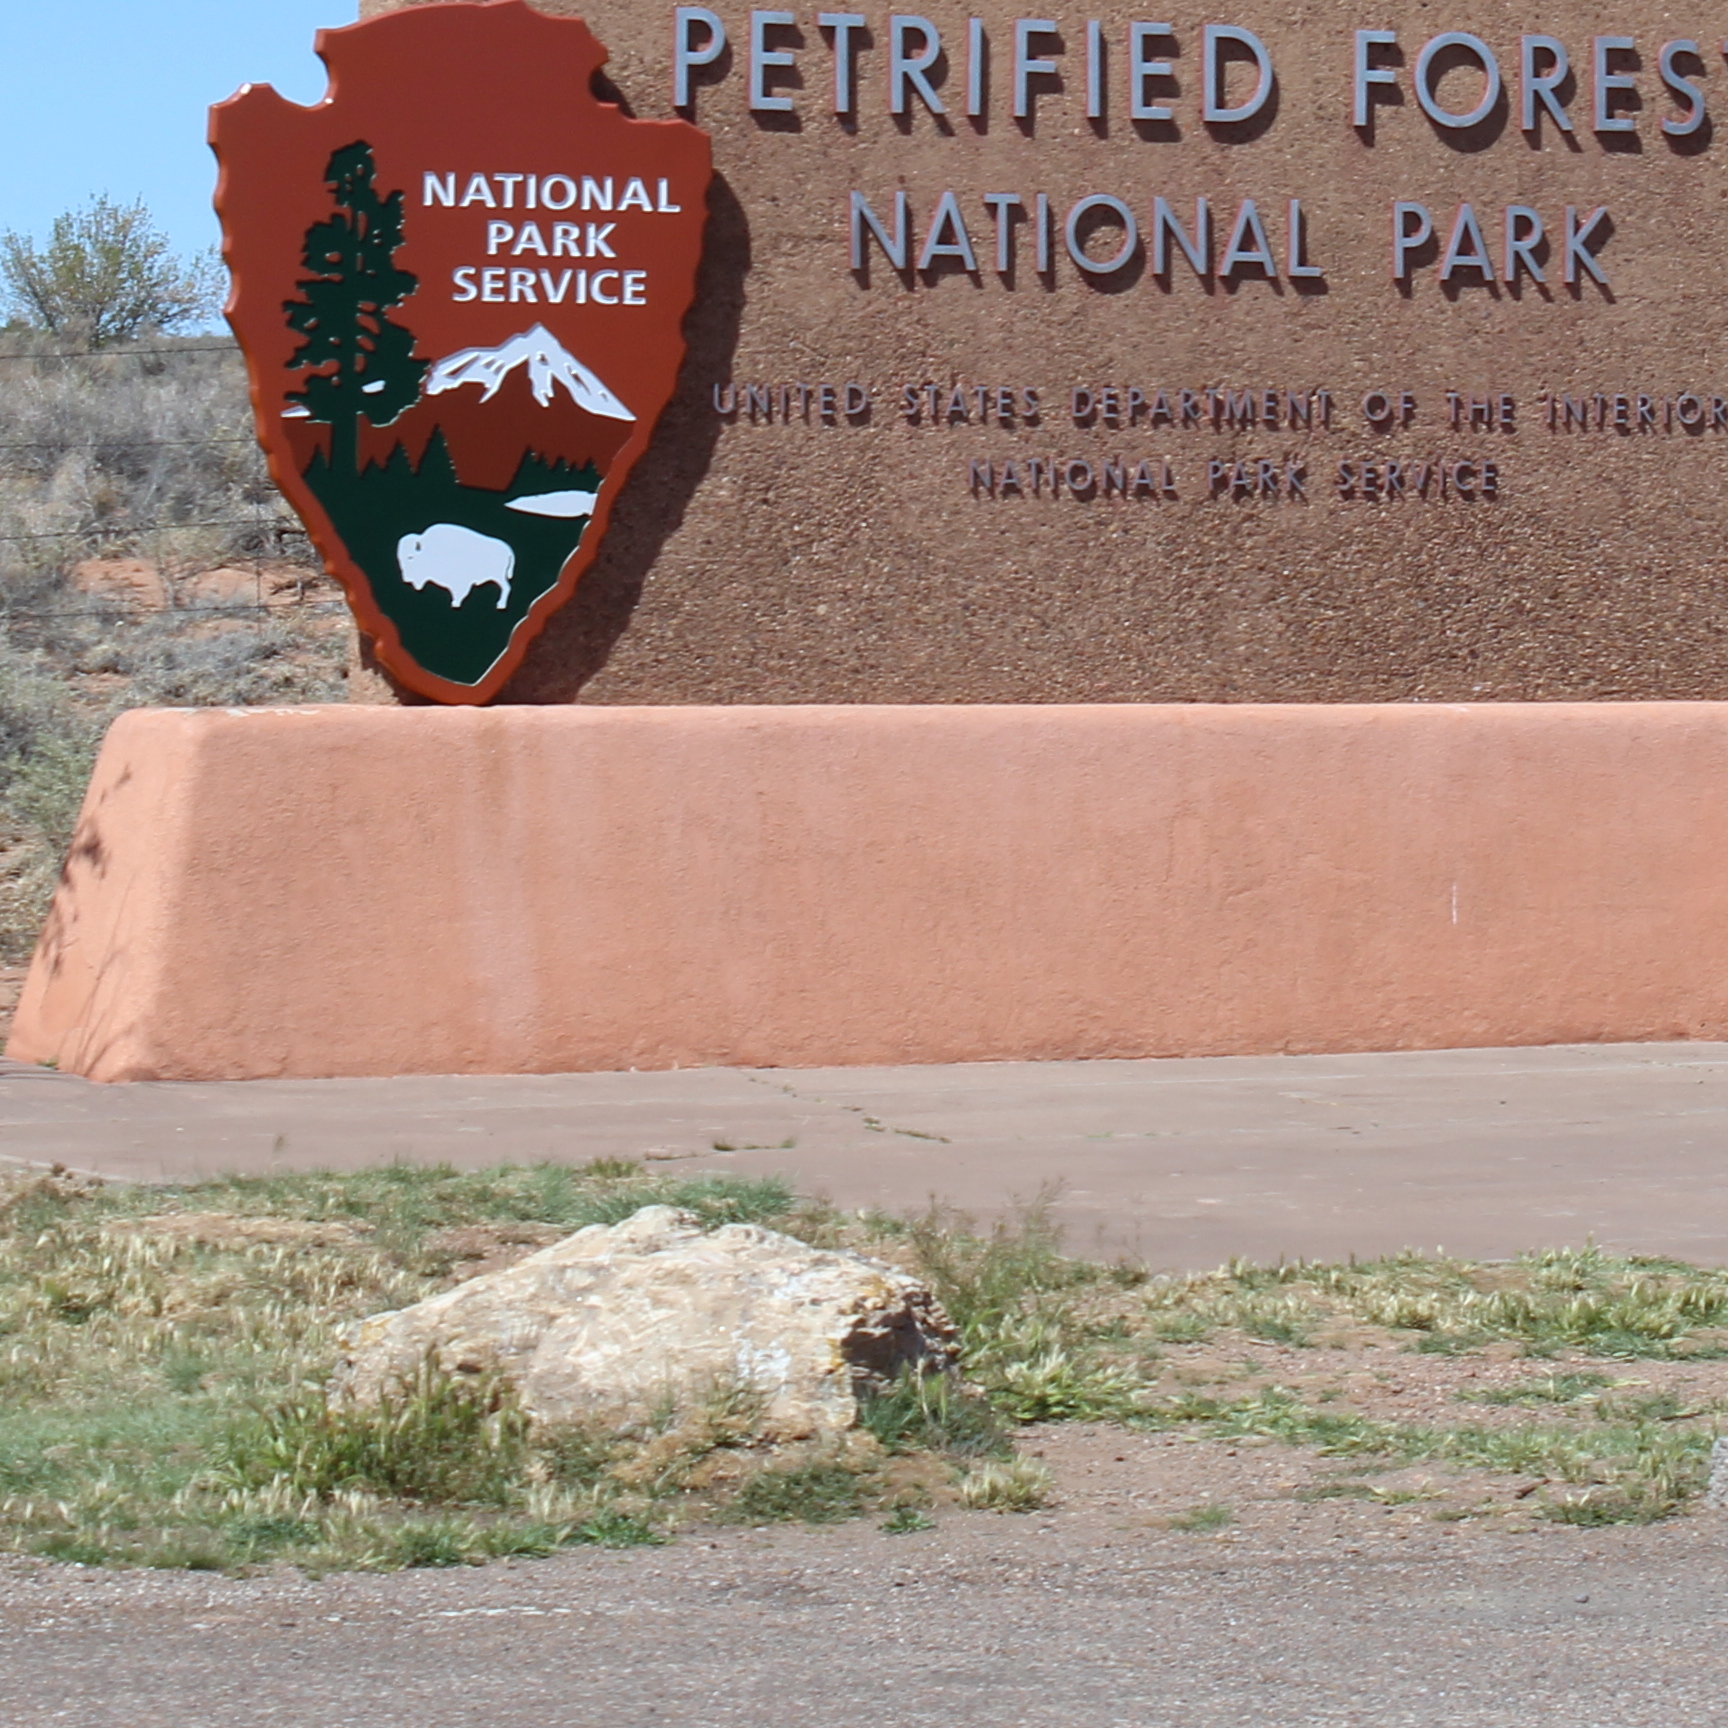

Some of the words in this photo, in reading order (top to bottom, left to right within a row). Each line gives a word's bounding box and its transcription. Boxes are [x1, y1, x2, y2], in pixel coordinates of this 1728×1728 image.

[673, 5, 1273, 124] PETRIFIED
[422, 170, 681, 214] NATIONAL
[486, 219, 617, 259] PARK
[849, 190, 1323, 278] NATIONAL
[1393, 201, 1612, 285] PARK
[451, 265, 647, 305] SERVICE
[713, 382, 870, 418] UNITED
[904, 383, 1039, 420] STATES
[1074, 386, 1334, 426] DEPARTMENT
[1362, 390, 1415, 424] OF
[1446, 391, 1515, 426] THE
[970, 458, 1178, 496] NATIONAL
[1210, 460, 1306, 496] PARK
[1338, 460, 1500, 496] SERVICE
